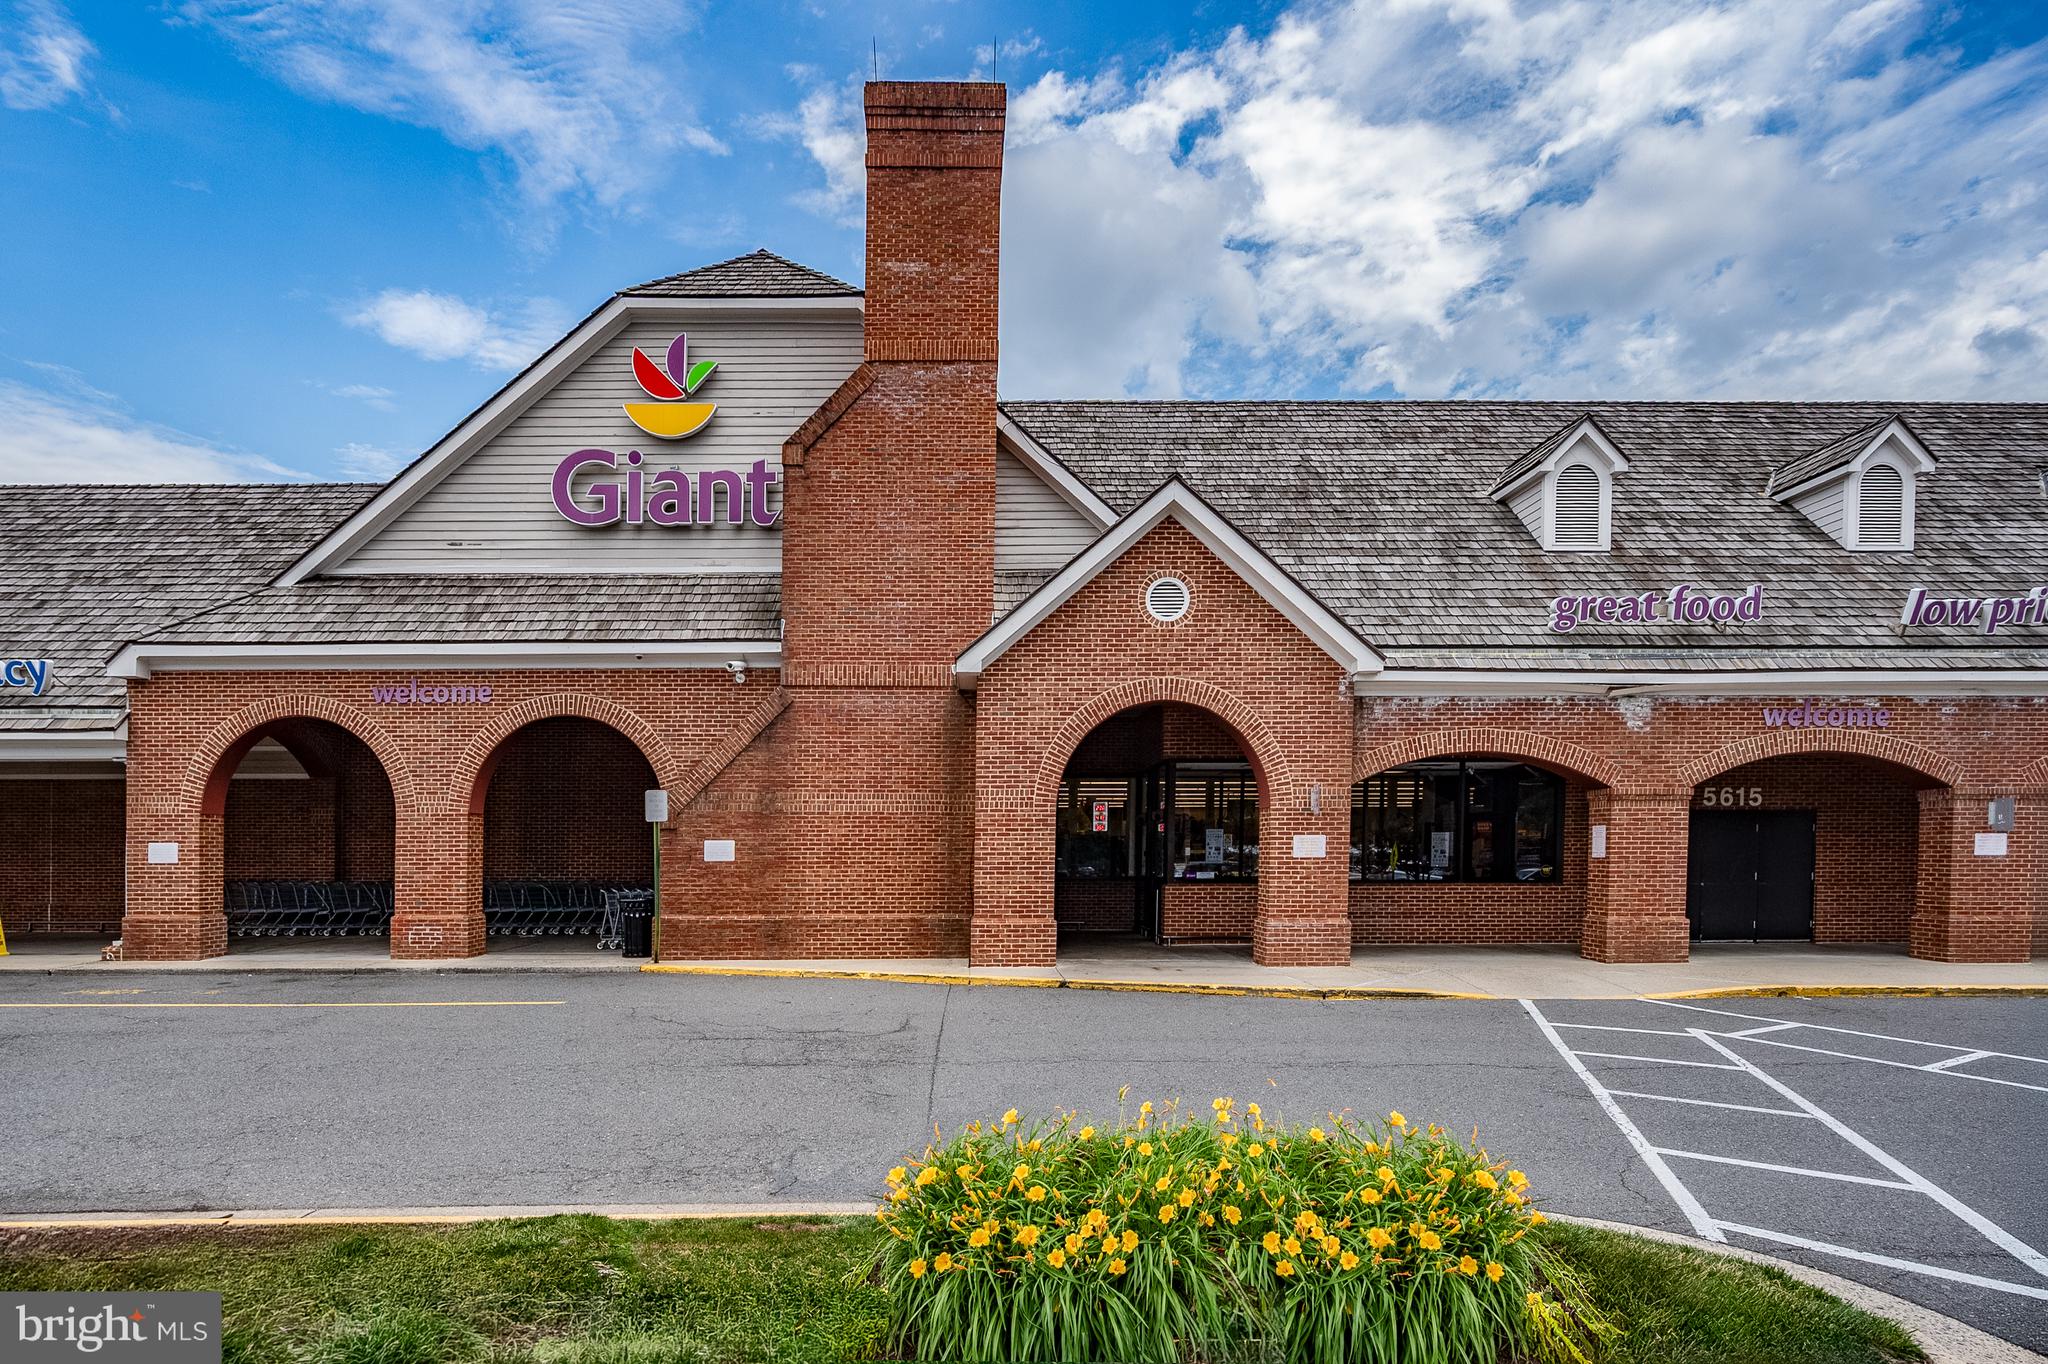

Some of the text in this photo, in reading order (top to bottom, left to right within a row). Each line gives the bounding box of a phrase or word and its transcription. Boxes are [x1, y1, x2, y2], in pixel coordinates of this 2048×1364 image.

[551, 448, 781, 527] Giant
[1550, 584, 1763, 632] great food
[1902, 586, 2048, 635] low pri
[0, 659, 48, 696] cy
[371, 678, 493, 704] welcome
[1762, 699, 1891, 727] welcome
[1703, 787, 1763, 806] 5615
